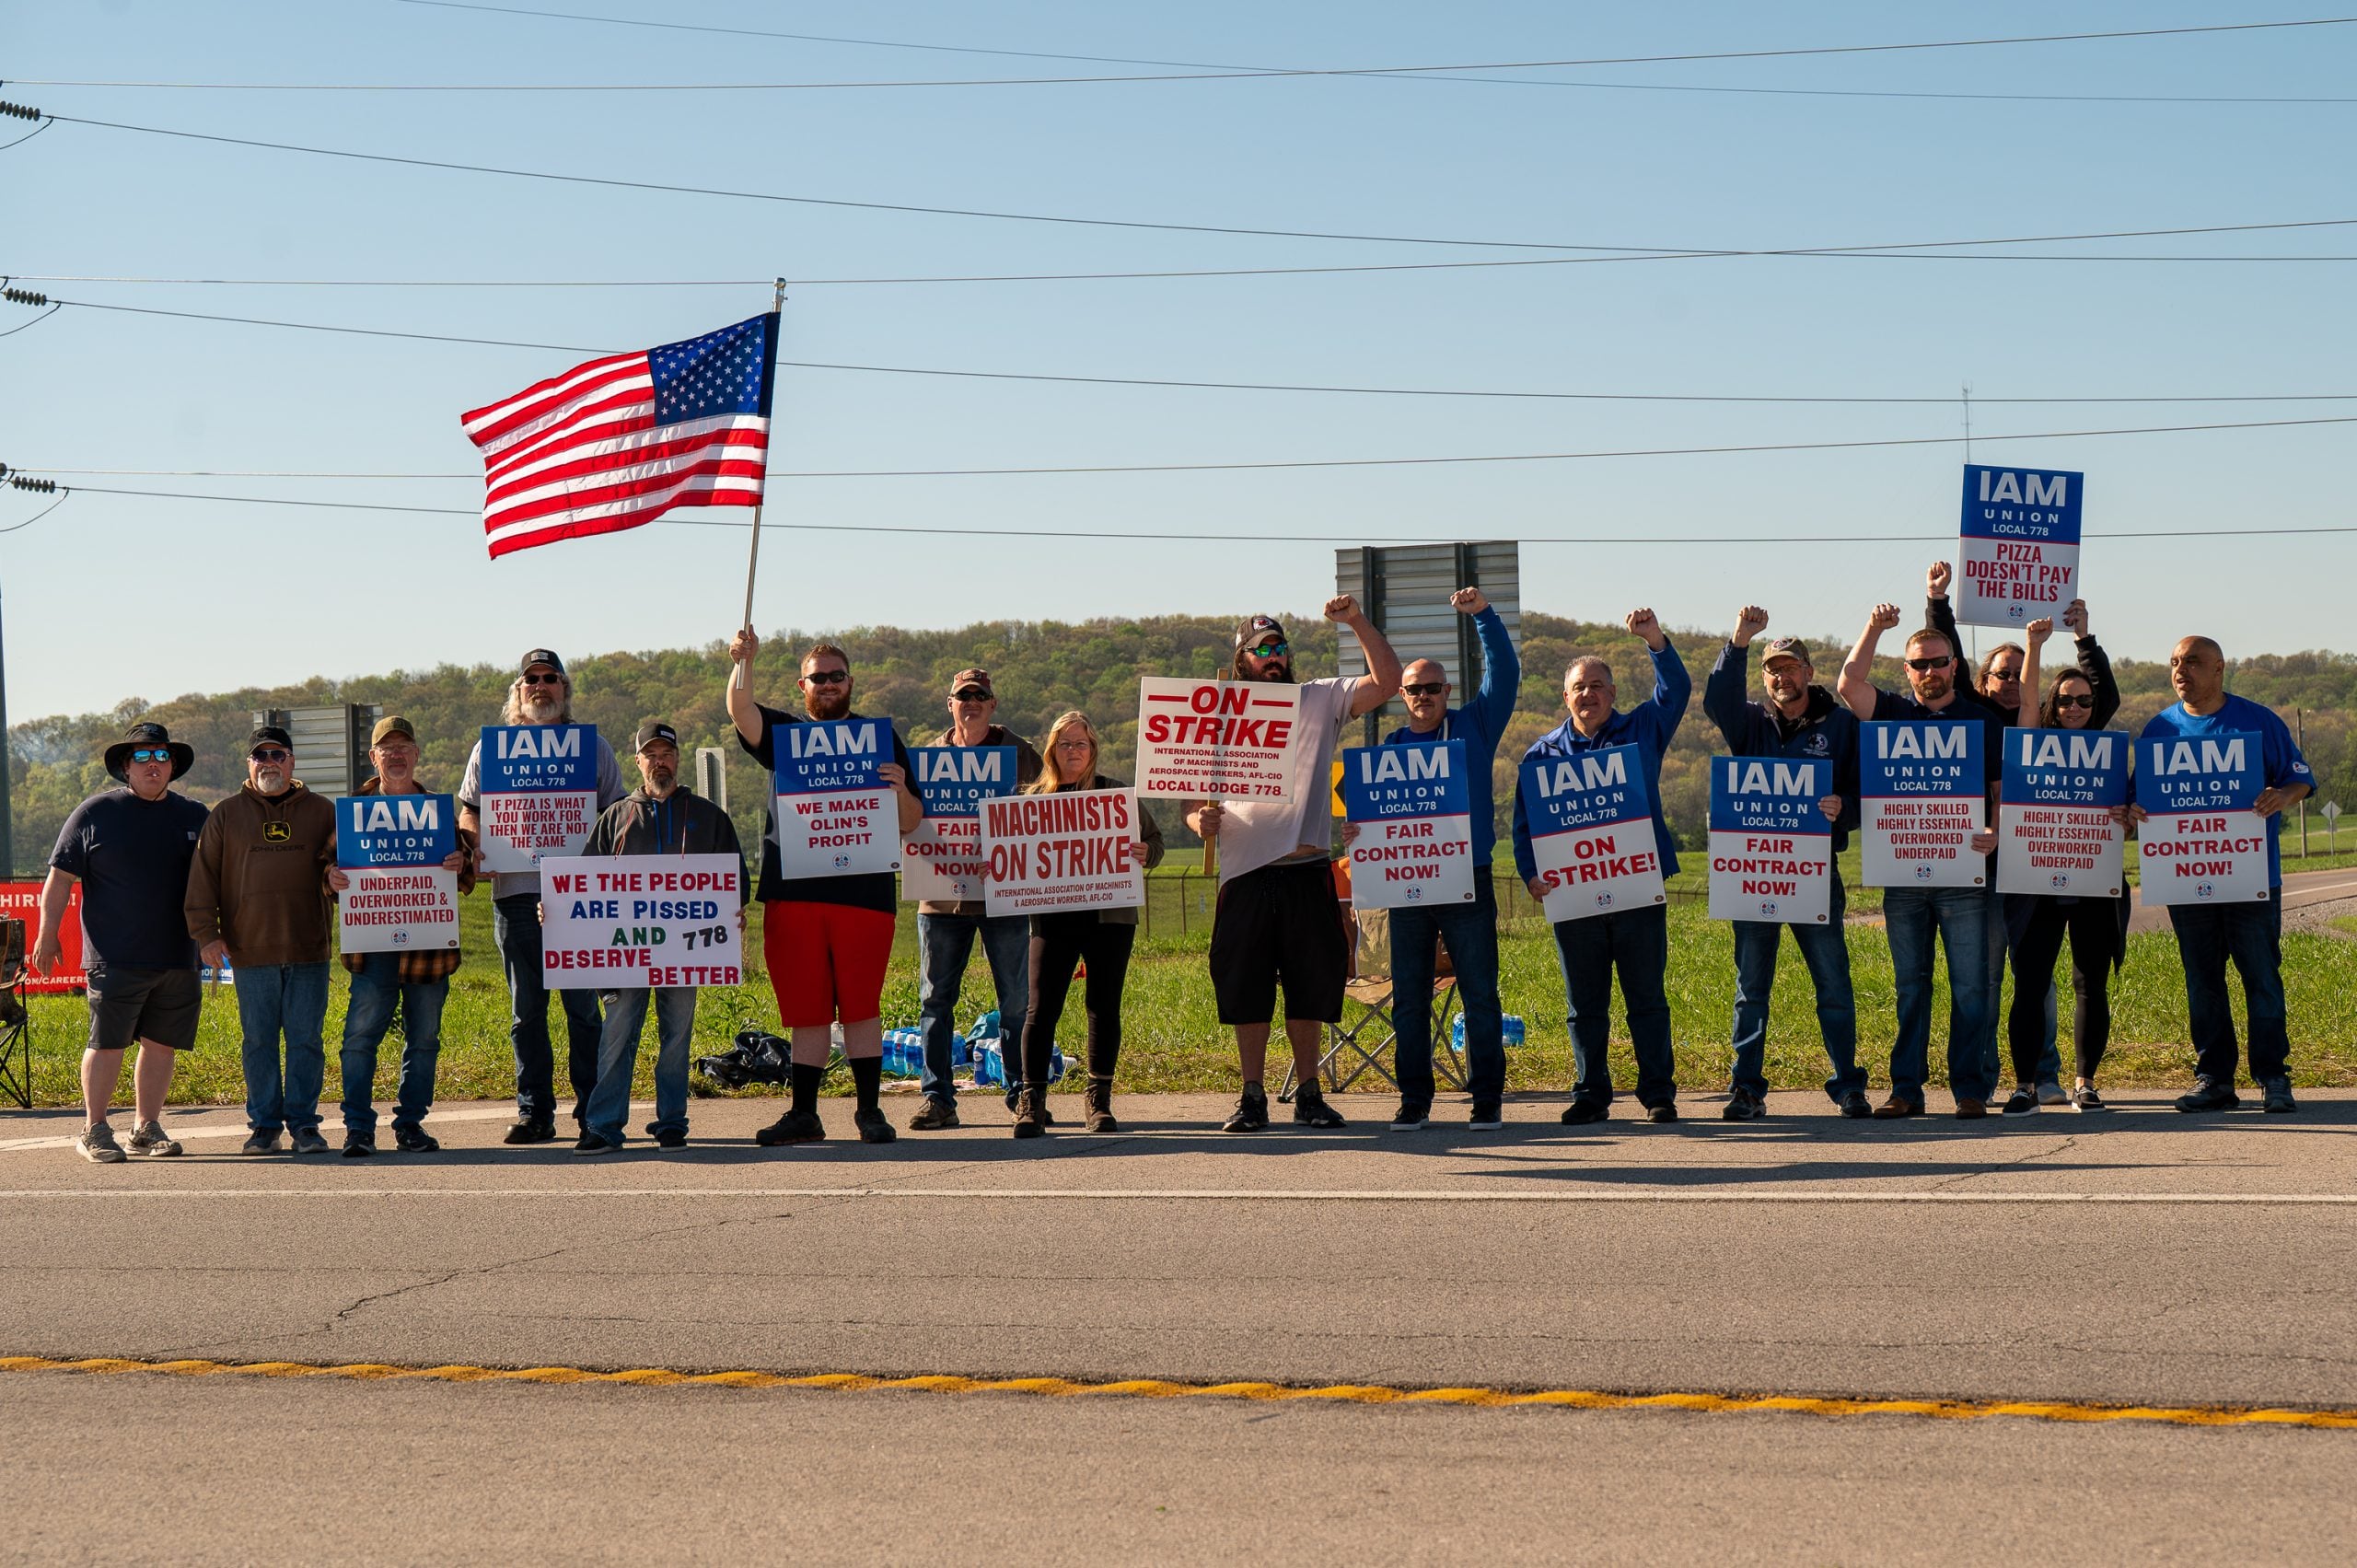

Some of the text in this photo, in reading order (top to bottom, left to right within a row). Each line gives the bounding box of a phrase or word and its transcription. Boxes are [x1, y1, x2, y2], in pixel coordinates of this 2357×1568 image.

[1980, 470, 2067, 506] IAM
[1984, 509, 2059, 523] UNION
[1992, 524, 2049, 536] LOCAL 778
[1997, 543, 2041, 563] PIZZA
[1966, 560, 2072, 584] DOESN'T PAY
[1977, 580, 2058, 602] THE BILLS
[1191, 686, 1250, 715] ON
[1145, 714, 1292, 749] STRIKE
[498, 729, 580, 759] IAM
[790, 724, 877, 758] IAM
[1878, 726, 1966, 759] IAM
[1155, 748, 1279, 760] INTERNATIONAL ASSOCIATION
[2022, 734, 2112, 770] IAM
[2154, 738, 2245, 775] IAM
[504, 764, 575, 774] UNION
[798, 761, 872, 774] UNION
[919, 751, 1000, 782] IAM
[1188, 760, 1238, 768] MACHINISTS
[1361, 747, 1450, 784] IAM
[1885, 766, 1960, 776] UNION
[809, 775, 864, 786] LOCAL 778
[1202, 770, 1246, 779] WORKERS,
[1537, 752, 1627, 798] IAM
[1728, 761, 1814, 796] IAM
[2027, 774, 2104, 787] UNION
[512, 778, 565, 787] LOCAL 778
[1148, 780, 1281, 796] LOCAL LODGE 778
[1894, 782, 1951, 791] LOCAL 778
[2162, 780, 2240, 794] UNION
[924, 789, 994, 799] UNION
[1370, 785, 1445, 801] UNION
[2036, 790, 2094, 801] LOCAL 778
[491, 797, 586, 811] IF PIZZA IS WHAT
[795, 798, 879, 815] WE MAKE
[933, 803, 979, 811] LOCAL 77
[1380, 801, 1436, 814] LOCAL 778
[1549, 792, 1624, 814] UNION
[1734, 801, 1807, 814] UNION
[2171, 796, 2231, 807] LOCAL 778
[354, 800, 438, 832] IAM
[495, 810, 581, 823] YOU WORK FOR
[988, 794, 1129, 838] MACHINISTS
[1561, 808, 1618, 826] LOCAL 778
[1884, 804, 1968, 815] HIGHLY SKILLED
[810, 816, 868, 830] OLIN'S
[1742, 817, 1798, 828] LOCAL 778
[1877, 819, 1974, 830] HIGHLY ESSENTIAL
[2024, 811, 2109, 826] HIGHLY SKILLED
[2177, 818, 2226, 834] FAIR
[489, 822, 588, 836] THEN WE ARE NOT
[938, 823, 981, 836] FAIR
[1386, 823, 1434, 840] FAIR
[2015, 826, 2113, 841] HIGHLY ESSENTIAL
[361, 837, 433, 849] UNION
[511, 836, 566, 848] THE SAME
[809, 832, 872, 848] PROFIT
[1890, 833, 1963, 844] OVERWORKED
[906, 842, 981, 856] CONTRA
[1353, 842, 1468, 863] CONTRACT
[1574, 835, 1616, 860] ON
[1747, 839, 1793, 854] FAIR
[1895, 848, 1956, 859] UNDERPAID
[2028, 841, 2101, 854] OVERWORKED
[2143, 838, 2263, 857] CONTRACT
[370, 852, 424, 862] LOCAL 778
[991, 835, 1131, 882] ON STRIKE
[2032, 856, 2094, 869] UNDERPAID
[935, 863, 979, 876] NOW
[1385, 864, 1440, 881] NOW!
[1542, 853, 1656, 889] STRIKE!
[1713, 857, 1827, 876] CONTRACT
[2176, 861, 2232, 877] NOW!
[360, 876, 436, 891] UNDERPAID,
[552, 873, 736, 894] WE THE PEOPLE
[995, 888, 1042, 898] INTERNATIONAL
[1044, 886, 1085, 895] ASSOCIATION
[1095, 880, 1132, 891] MACHINISTS
[1742, 880, 1795, 896] NOW!
[0, 893, 75, 908] HIRI!
[350, 892, 447, 909] OVERWORKED &
[1020, 897, 1054, 907] AEROSPACE
[1056, 896, 1088, 904] WORKERS,
[1089, 893, 1112, 901] AFL-CIO
[570, 900, 718, 919] ARE PISSED
[344, 909, 454, 926] UNDERESTIMATED
[611, 925, 727, 950] AND 778
[545, 948, 652, 969] DESERVE
[649, 967, 739, 986] BETTER
